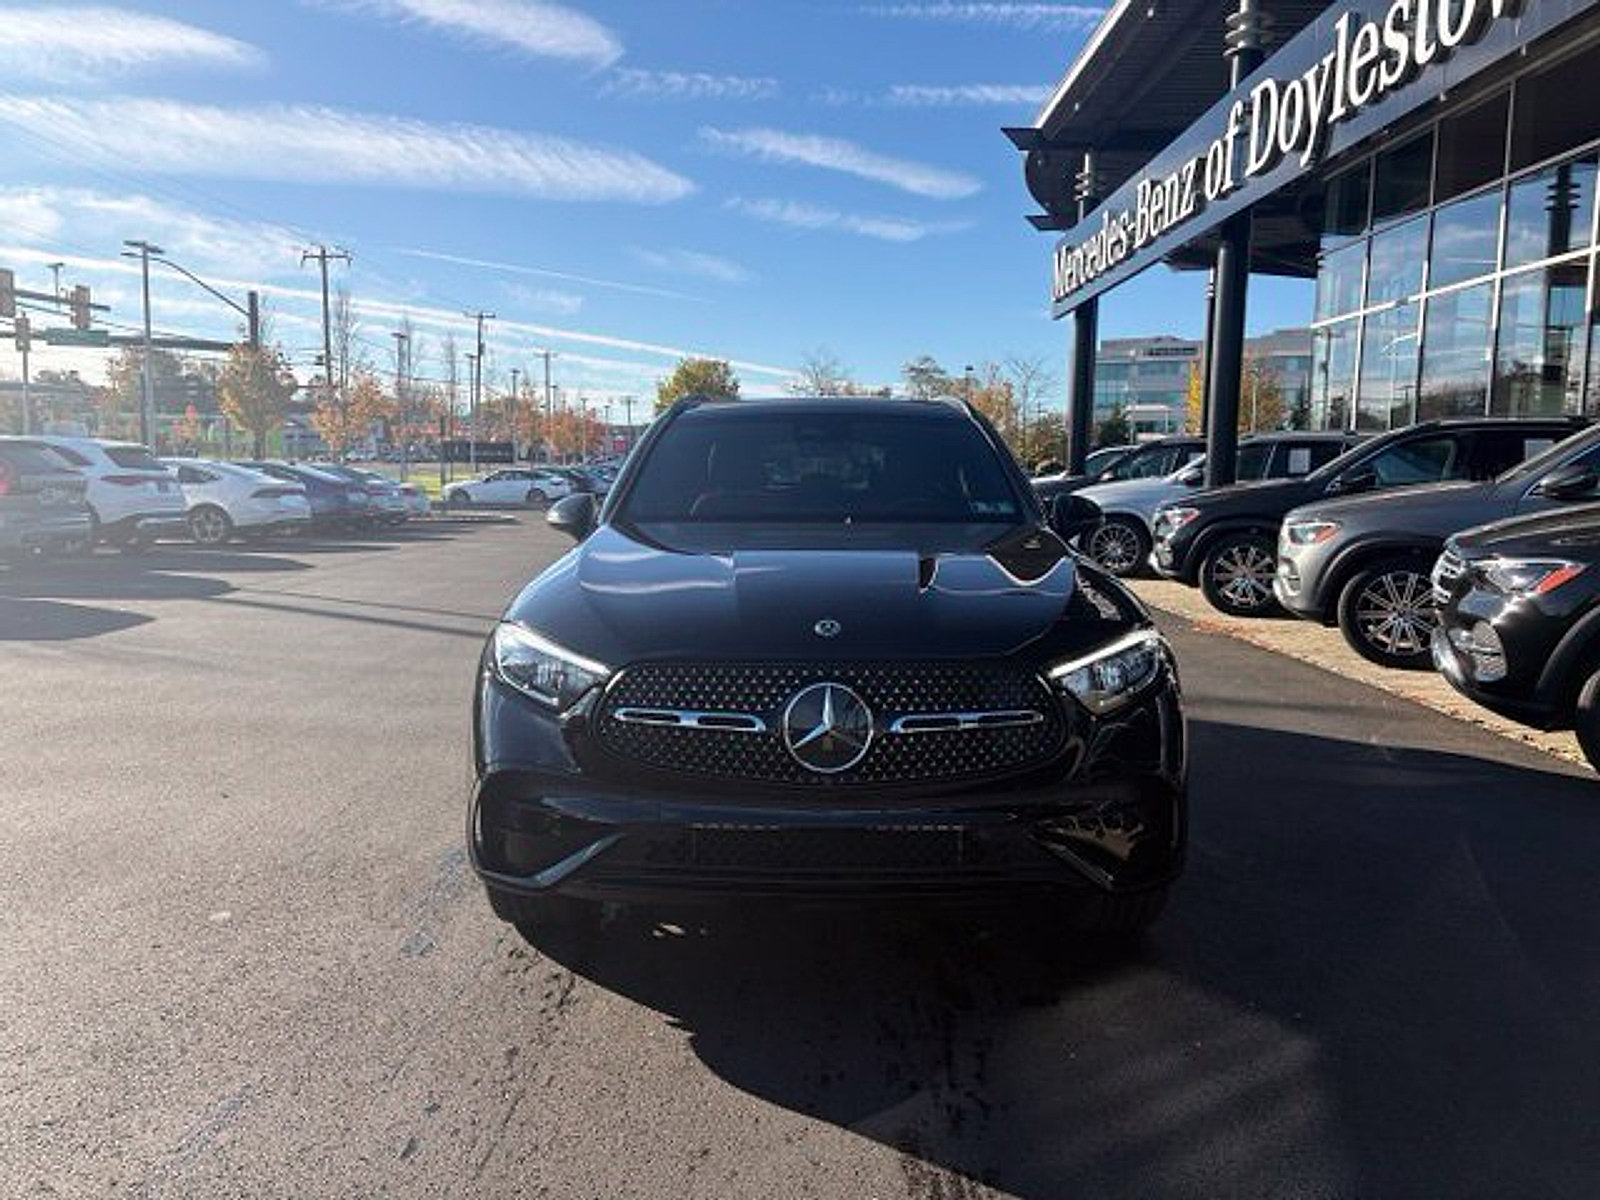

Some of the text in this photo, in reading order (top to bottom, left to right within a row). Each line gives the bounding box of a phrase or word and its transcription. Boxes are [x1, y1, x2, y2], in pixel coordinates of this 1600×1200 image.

[1053, 0, 1503, 301] Mercedes-Benz of Doylest
